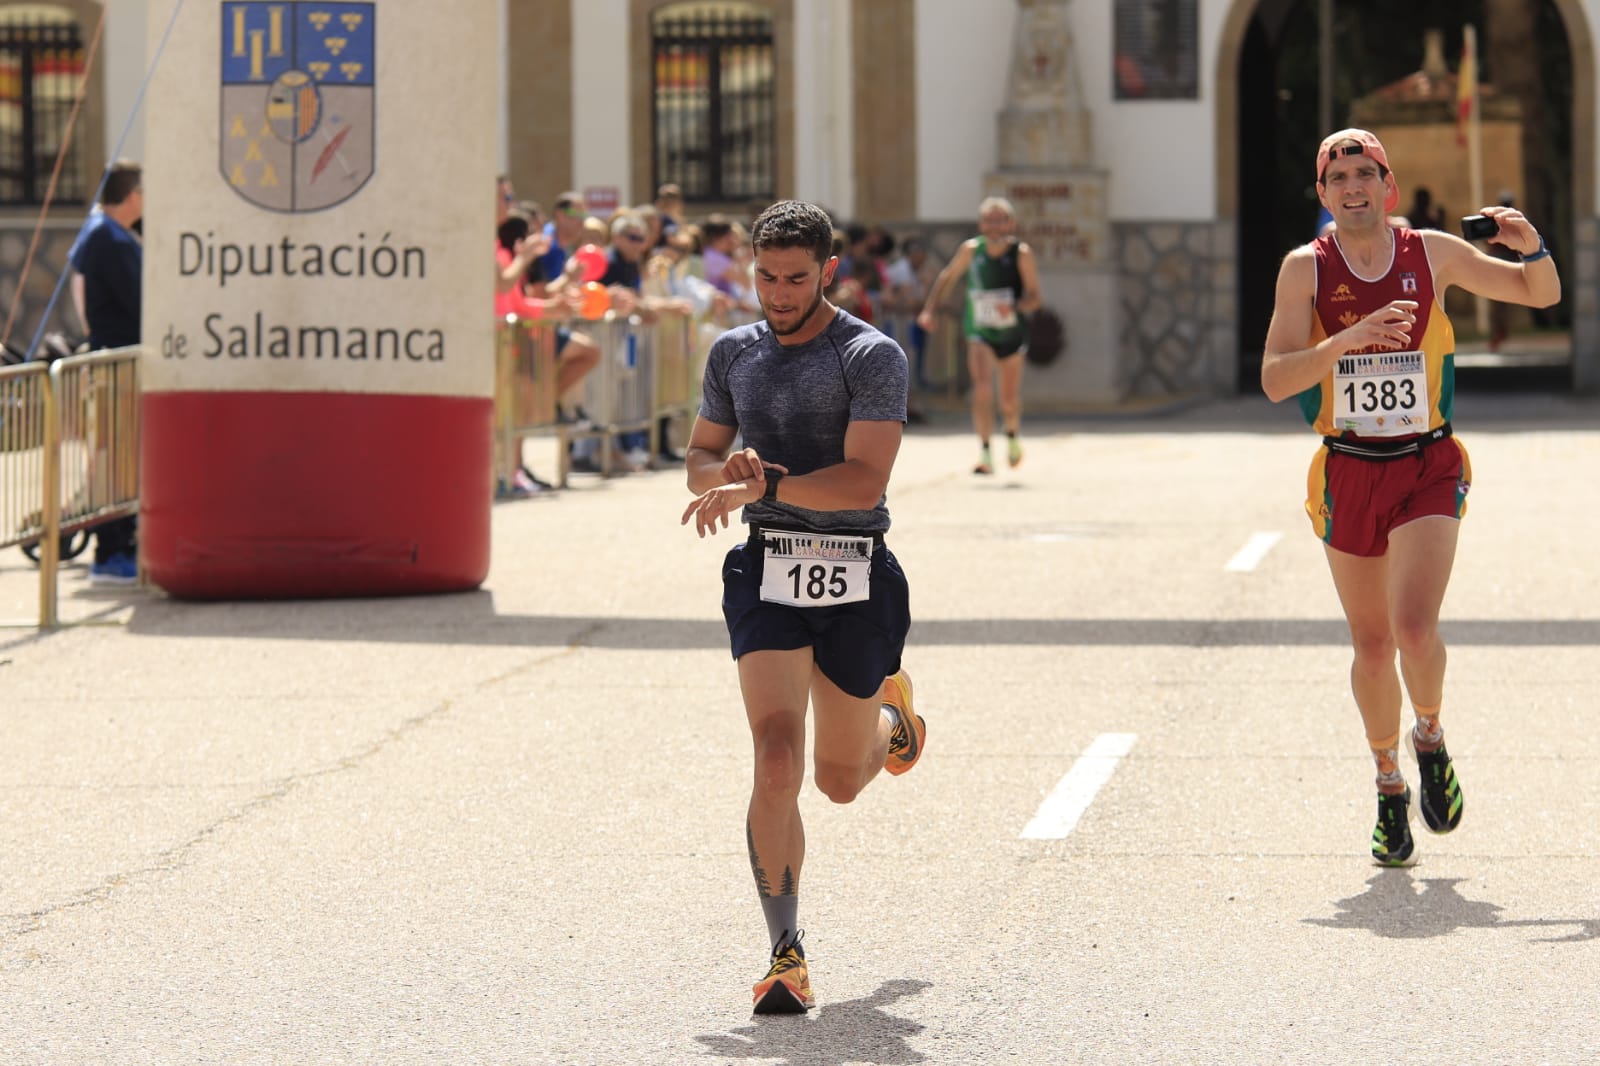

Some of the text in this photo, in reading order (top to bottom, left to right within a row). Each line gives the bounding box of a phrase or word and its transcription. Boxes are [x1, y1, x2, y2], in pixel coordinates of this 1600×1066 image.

[179, 231, 426, 288] Diputación
[161, 311, 445, 361] de Salamanca
[1338, 359, 1355, 374] XII
[1358, 358, 1372, 366] SAN
[1344, 379, 1416, 413] 1383
[772, 537, 792, 555] XII
[796, 539, 811, 547] SAN
[788, 564, 847, 599] 185
